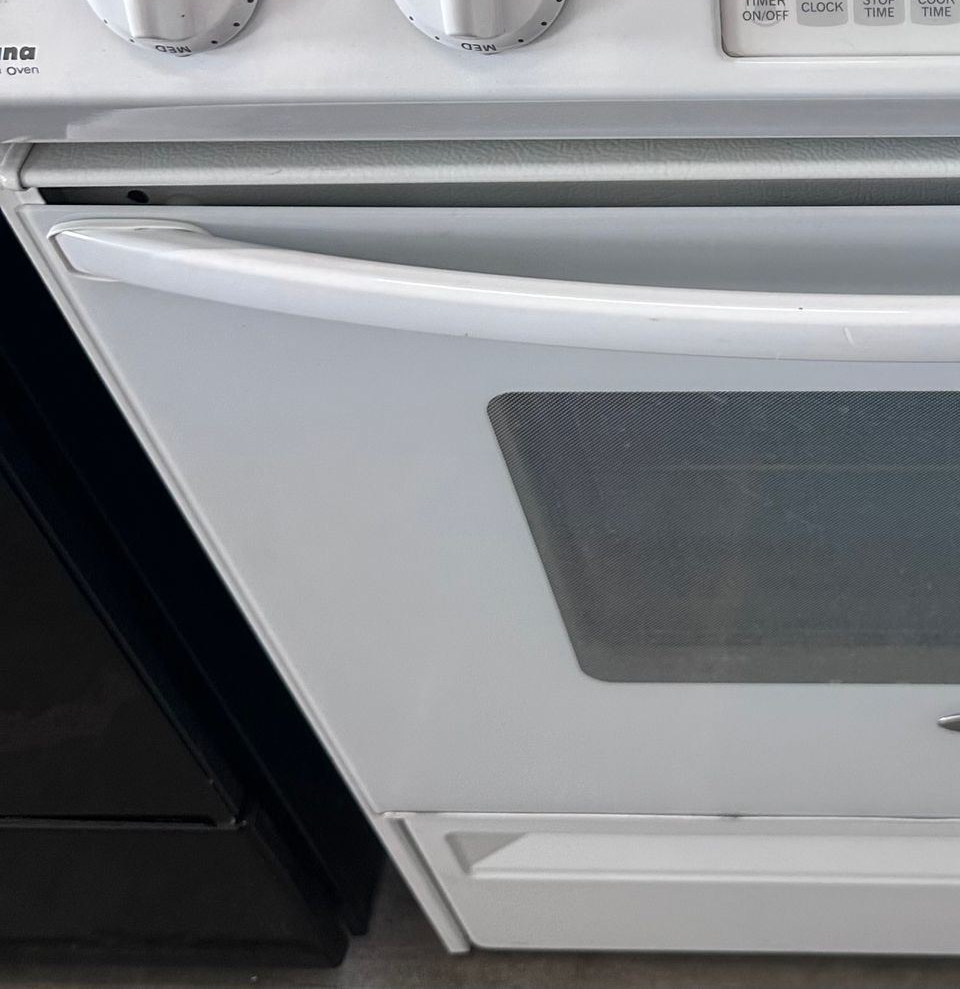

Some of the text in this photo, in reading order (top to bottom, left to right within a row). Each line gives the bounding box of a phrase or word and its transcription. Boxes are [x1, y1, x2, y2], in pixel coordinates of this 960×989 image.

[801, 1, 844, 13] CLOCK
[863, 6, 895, 18] TIME
[921, 6, 952, 18] TIME
[742, 9, 789, 22] ON/OFF
[155, 44, 192, 54] MED
[460, 42, 497, 52] MED
[6, 66, 40, 75] Oven
